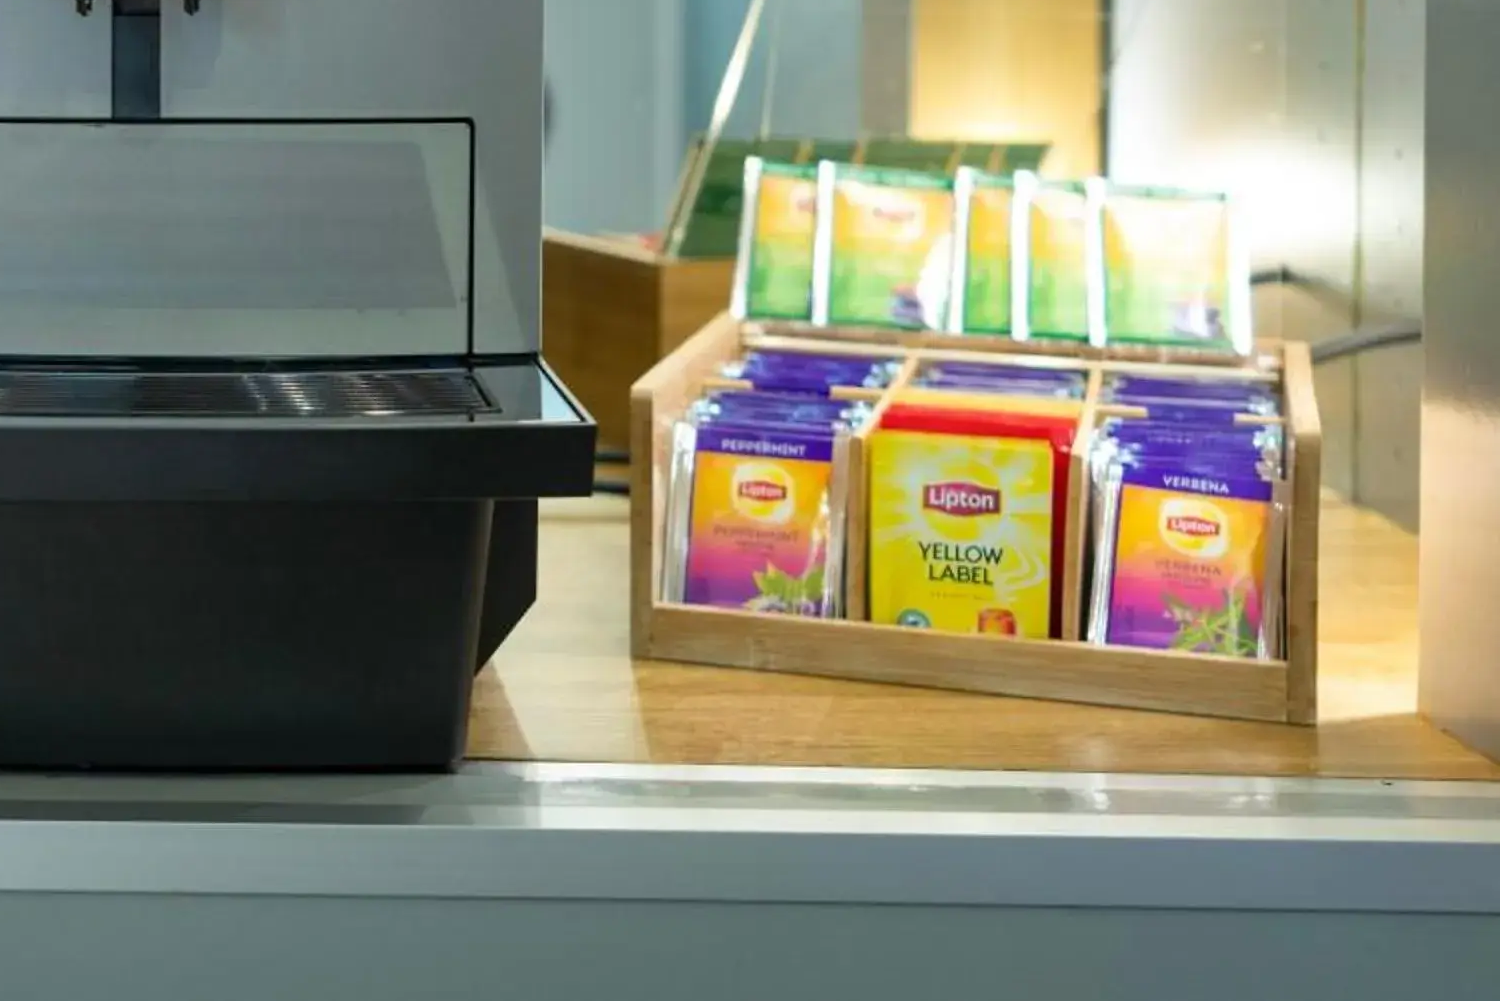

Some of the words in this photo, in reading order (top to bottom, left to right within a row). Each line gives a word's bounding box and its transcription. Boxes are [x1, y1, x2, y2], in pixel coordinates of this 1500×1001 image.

[721, 438, 807, 456] PEPPERMINT
[741, 482, 784, 499] Lipton
[1162, 474, 1230, 494] VERBENA
[928, 486, 995, 510] Lipton
[1170, 517, 1217, 536] Lipton
[918, 540, 1004, 565] YELLOW
[928, 564, 994, 586] LABEL
